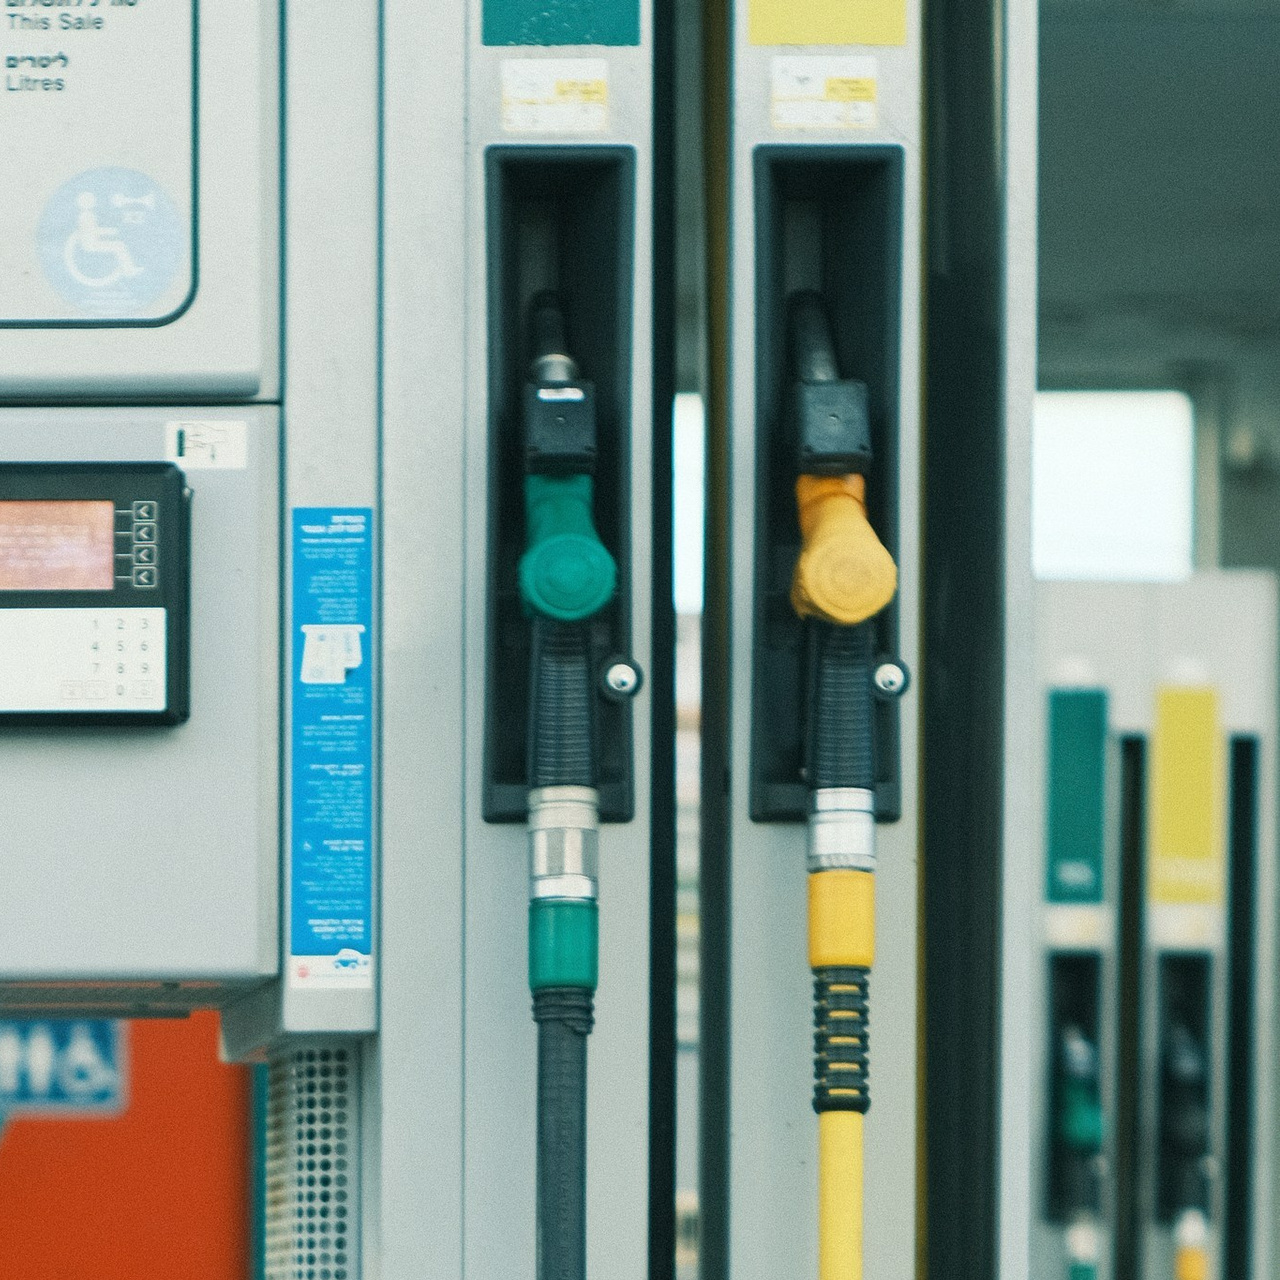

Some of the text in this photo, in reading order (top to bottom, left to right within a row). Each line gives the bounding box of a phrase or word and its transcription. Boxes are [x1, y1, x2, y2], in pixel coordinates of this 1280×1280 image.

[6, 13, 104, 31] This Sale
[6, 74, 65, 91] Litres
